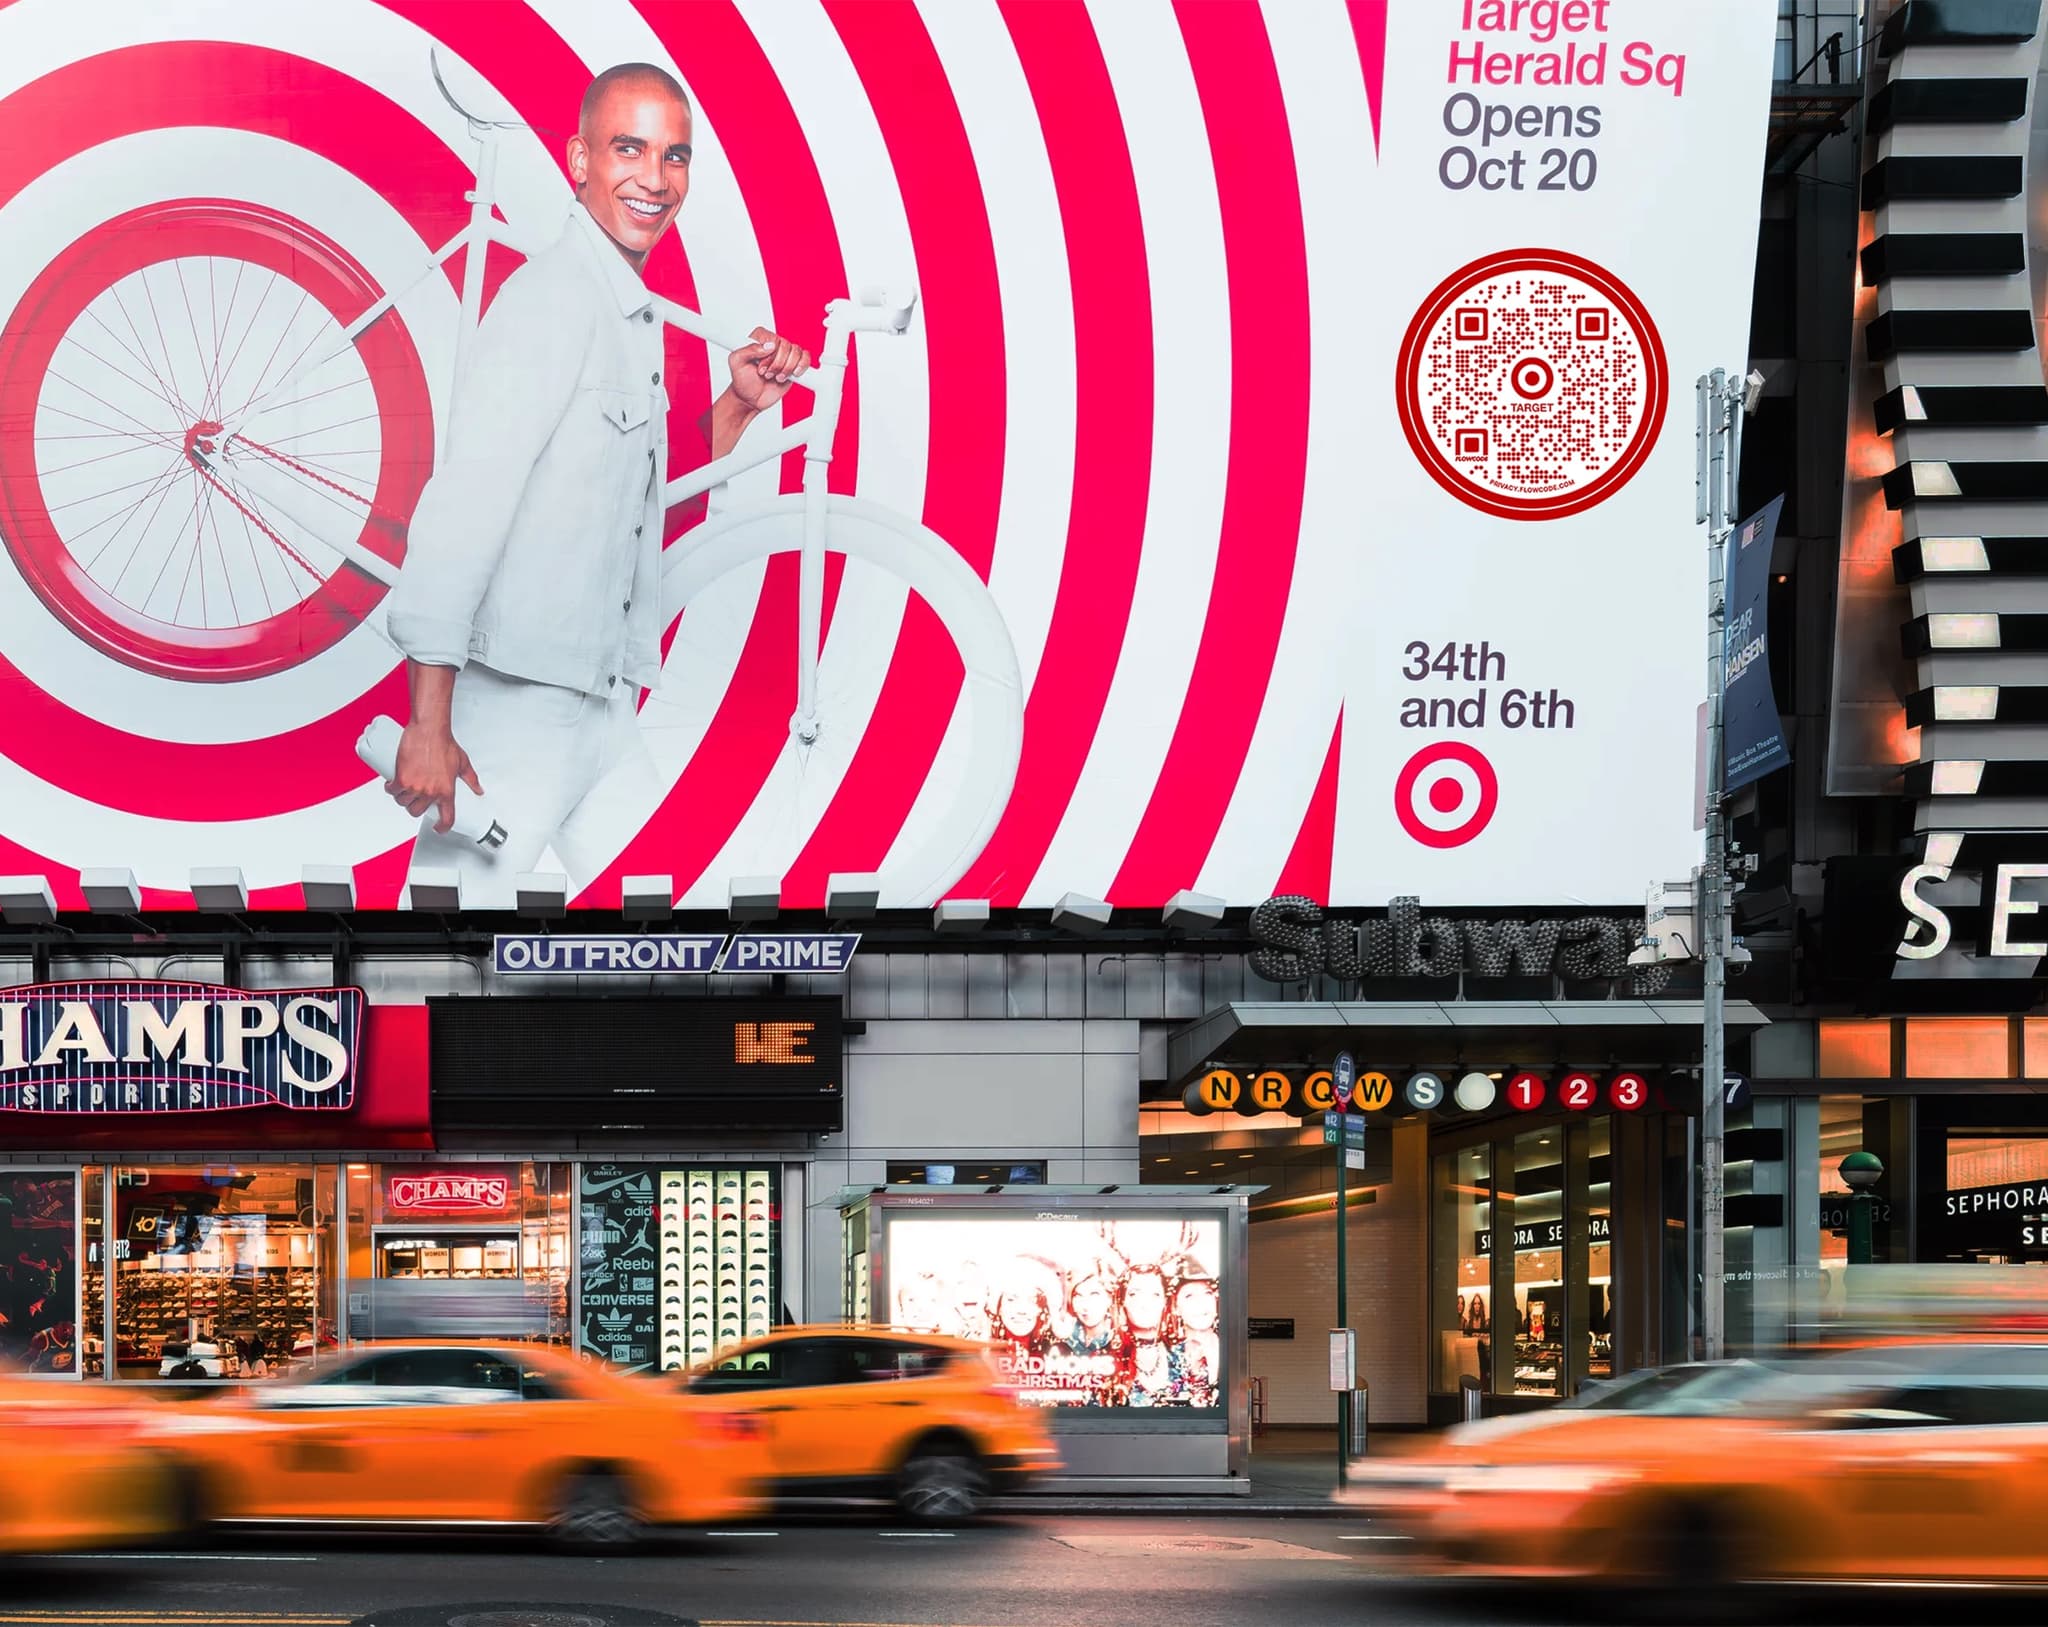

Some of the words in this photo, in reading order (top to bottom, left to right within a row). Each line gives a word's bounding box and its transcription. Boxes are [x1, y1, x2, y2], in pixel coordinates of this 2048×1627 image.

[1461, 0, 1609, 43] Target
[1448, 41, 1607, 86] Herald
[1620, 41, 1686, 97] Sq
[1443, 92, 1602, 147] Opens
[1438, 146, 1526, 190] Oct
[1537, 148, 1598, 191] 20
[1510, 403, 1554, 413] TARGET
[1489, 479, 1576, 494] PRIVACY.FLOWCODE.COM
[1726, 607, 1753, 644] DEAR
[1402, 641, 1506, 681] 34th
[1725, 633, 1765, 682] HANSEN
[1400, 688, 1487, 728] and
[1500, 688, 1575, 729] 6th
[1895, 864, 2048, 960] SE
[503, 940, 713, 969] OUTFRONT
[737, 940, 844, 968] PRIME
[735, 1023, 816, 1064] WE
[22, 1083, 203, 1106] SPORTS
[1211, 1077, 1232, 1101] N
[1263, 1078, 1283, 1102] R
[1310, 1077, 1334, 1103] Q
[1361, 1079, 1388, 1103] W
[1414, 1077, 1436, 1102] S
[1517, 1079, 1531, 1104] 1
[1569, 1079, 1589, 1104] 2
[1618, 1079, 1639, 1104] 3
[1723, 1079, 1743, 1104] 7
[395, 1181, 505, 1205] CHAMPS
[1946, 1186, 2048, 1215] SEPHORA
[624, 1205, 655, 1217] adid
[1035, 1212, 1079, 1221] JCDecaux
[581, 1230, 620, 1245] PUMA
[581, 1294, 654, 1306] CONVERSE
[597, 1332, 633, 1342] adidas
[998, 1356, 1044, 1374] BAD
